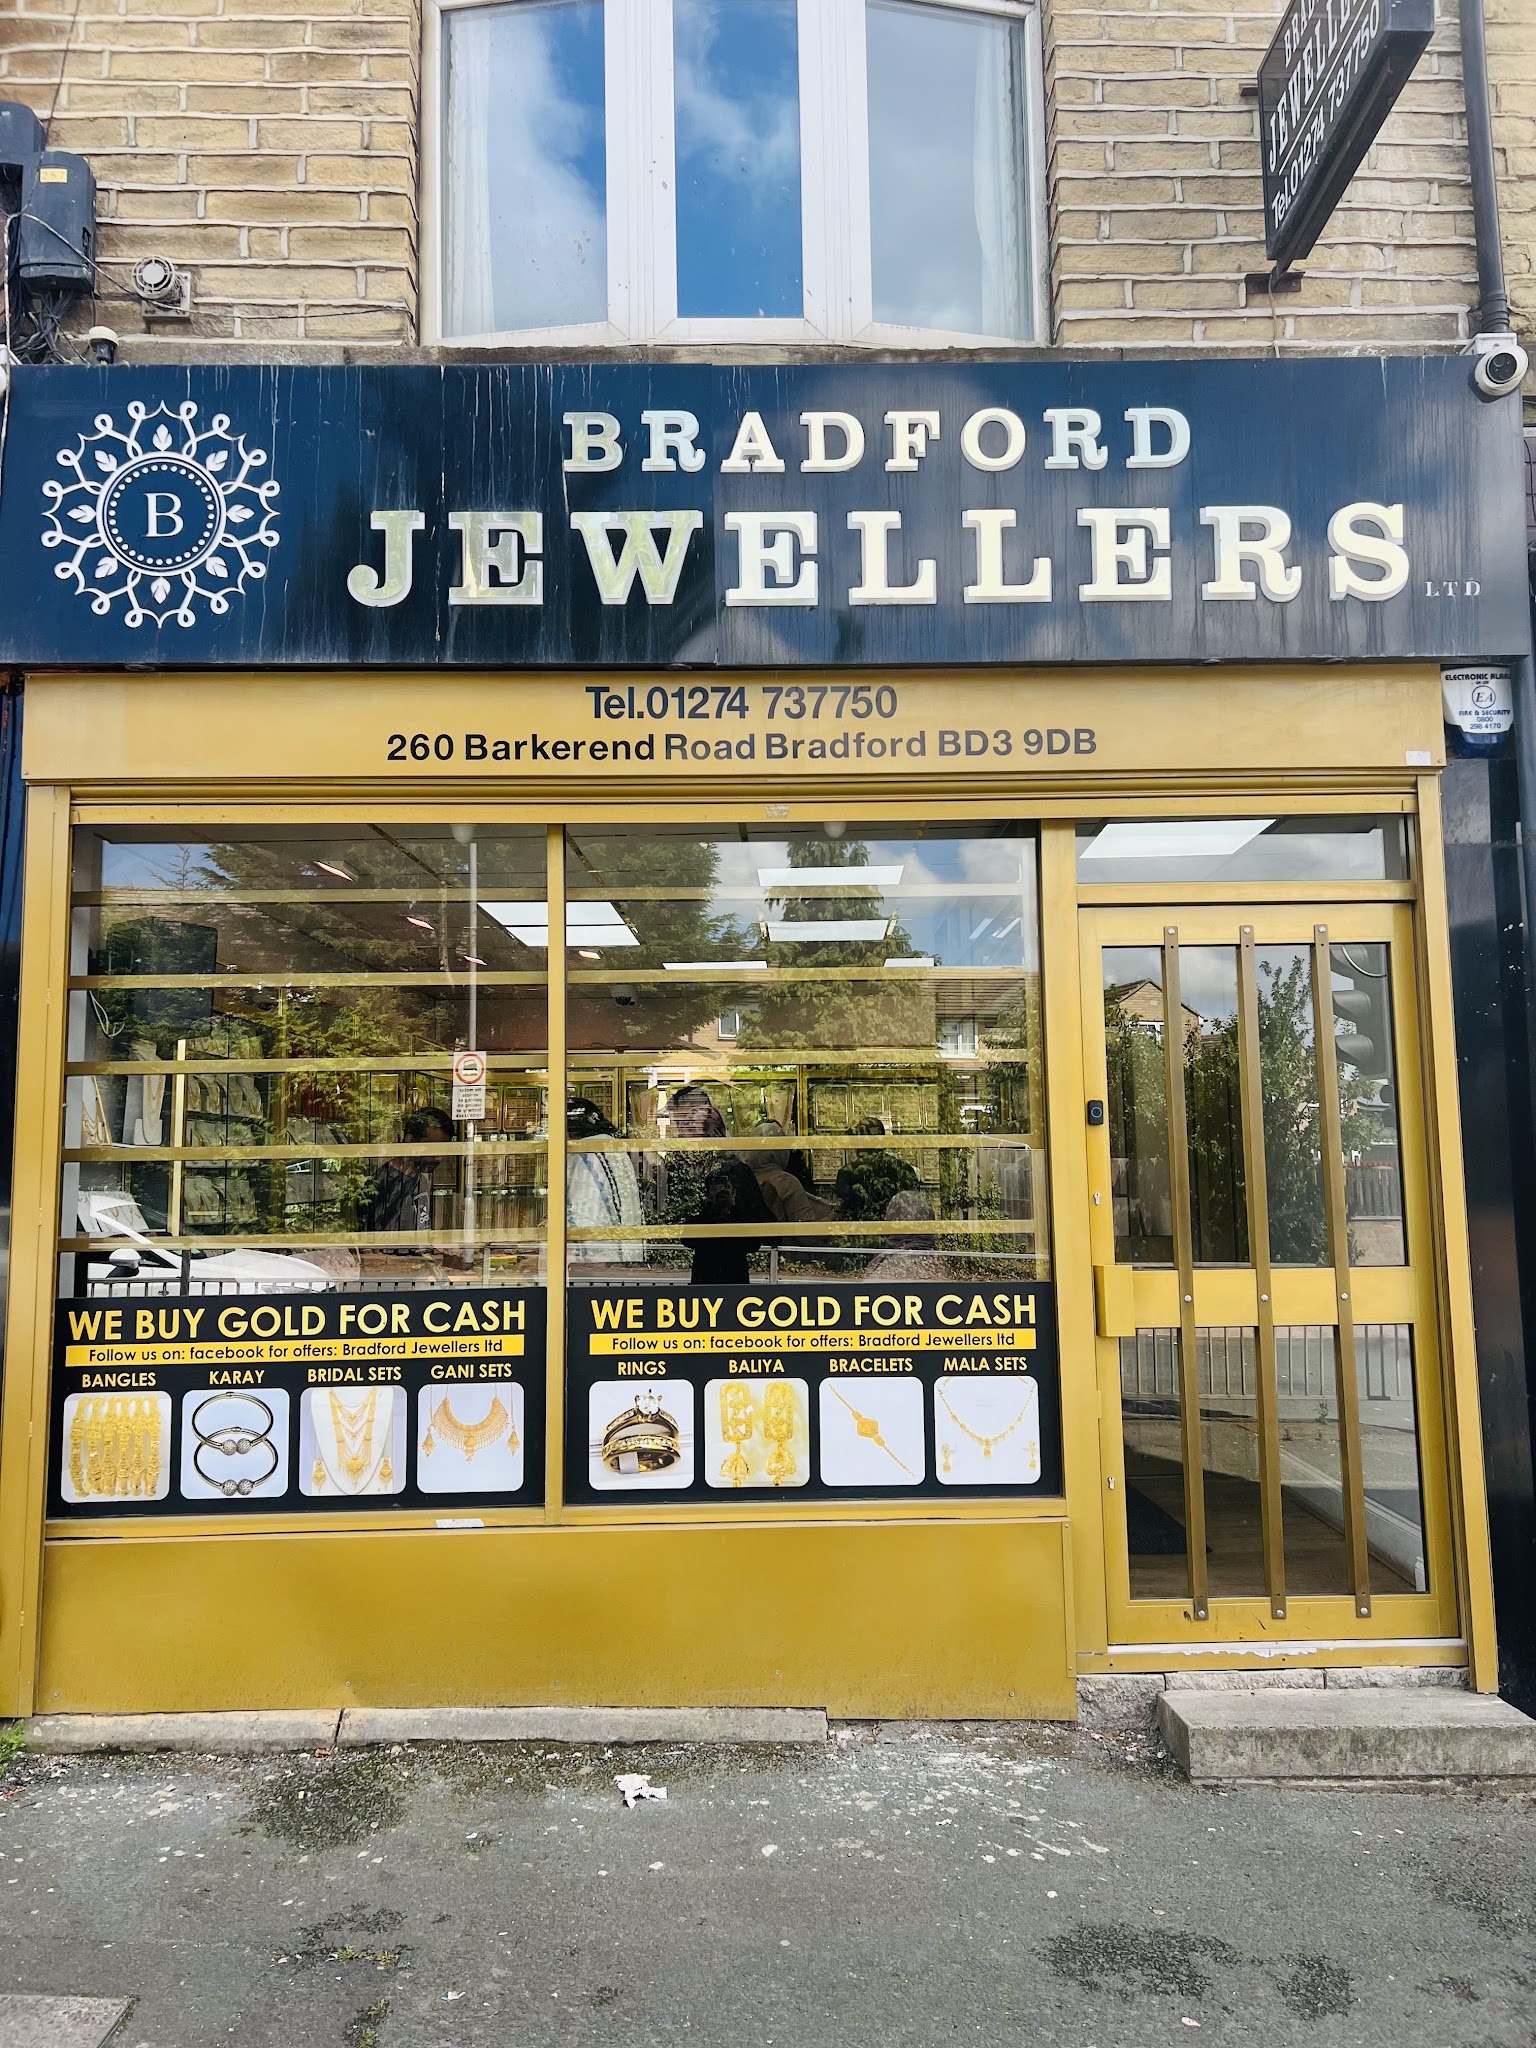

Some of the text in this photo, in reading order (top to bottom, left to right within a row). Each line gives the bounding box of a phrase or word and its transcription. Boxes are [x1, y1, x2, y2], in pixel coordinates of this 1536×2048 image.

[1327, 0, 1380, 122] 737750
[562, 406, 1192, 474] BRADFORD
[144, 492, 185, 538] B
[346, 501, 1411, 608] JEWELLERS
[1424, 580, 1481, 597] LTD
[1445, 673, 1488, 681] ELECTRONIC
[584, 685, 898, 719] Tel.01274 737750
[1475, 692, 1493, 702] EA
[387, 728, 1097, 761] 260 Barkerend Road Bradford BD3 9DB
[68, 1300, 525, 1341] WE BUY GOLD FOR CASH
[591, 1294, 1036, 1330] WE BUY GOLD FOR CASH
[612, 1332, 1015, 1350] Follow us on: facebook for offers: Bradford Jewellers ltd
[89, 1339, 503, 1362] Follow us on: facebook for offers: Bradford Jewellers ltd
[430, 1362, 512, 1380] GANI SETS
[617, 1360, 667, 1376] RINGS
[728, 1358, 785, 1374] BALIYA
[829, 1357, 913, 1373] BRACELETS
[943, 1356, 1028, 1371] MALA SETS
[82, 1372, 157, 1388] BANGLES
[209, 1369, 265, 1385] KARAY
[307, 1366, 402, 1383] BRIDAL SETS
